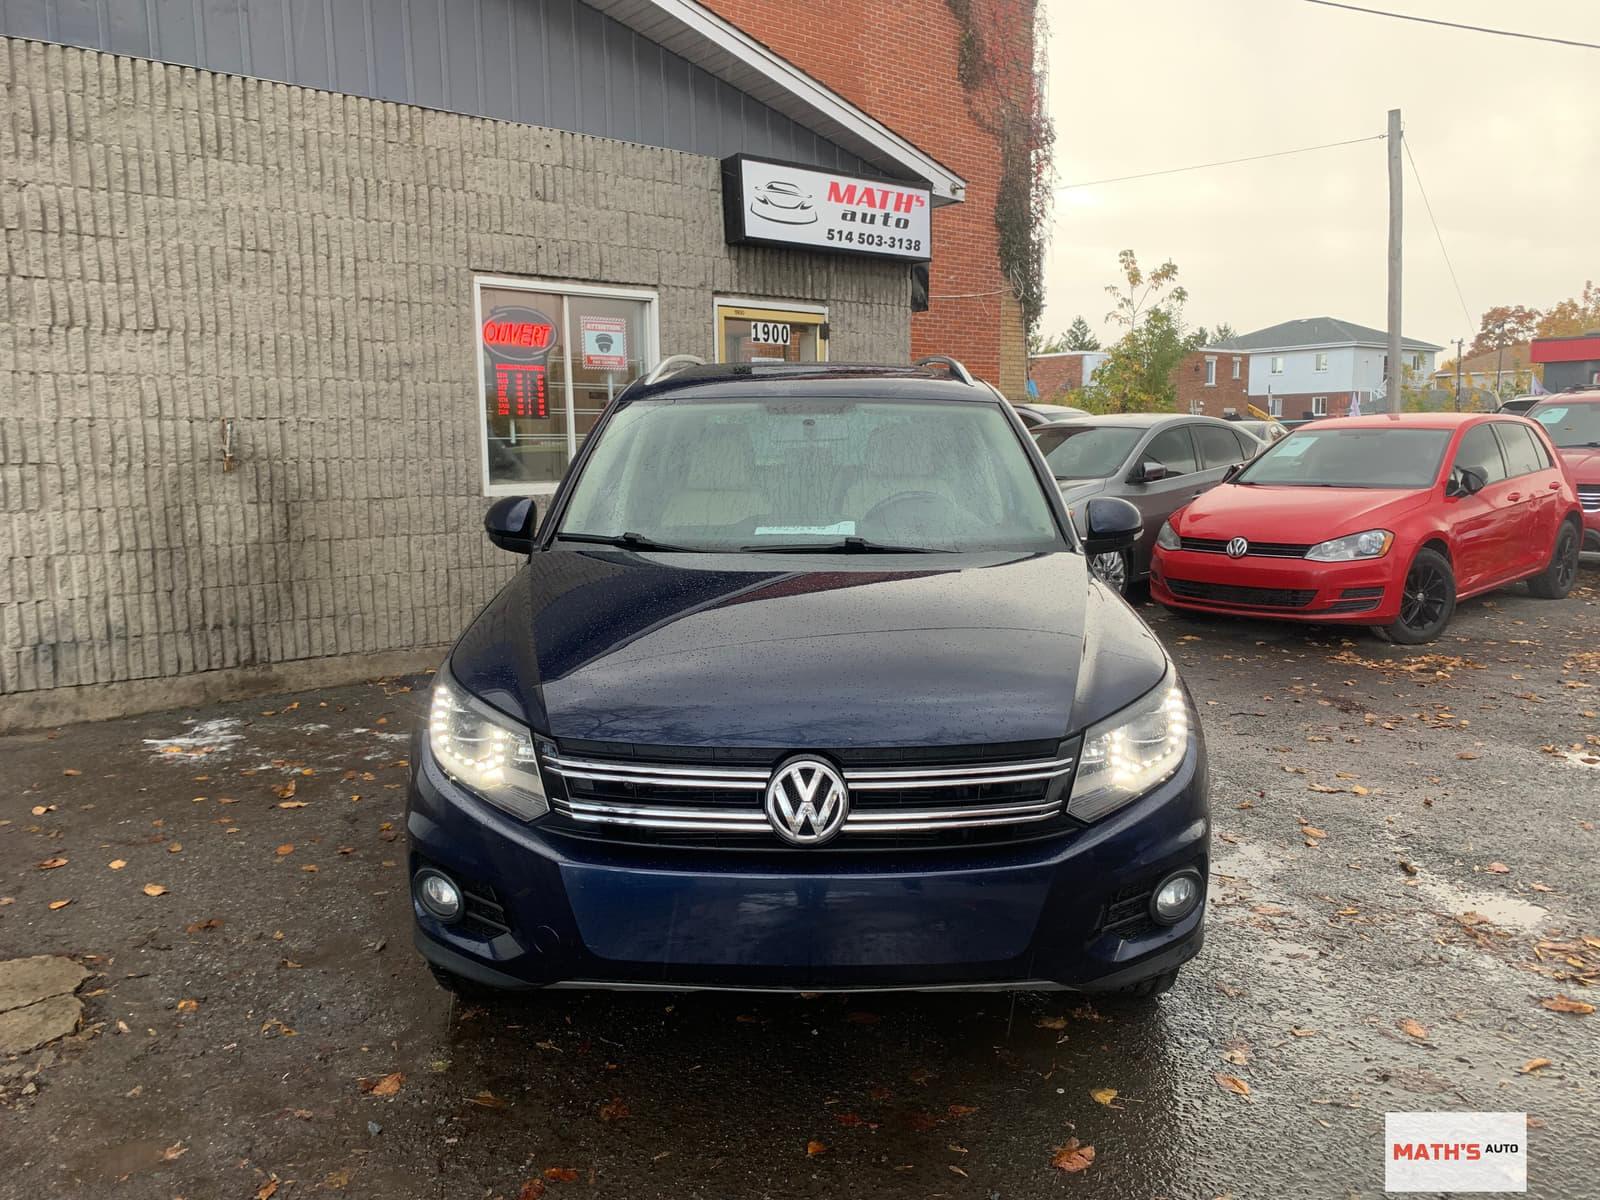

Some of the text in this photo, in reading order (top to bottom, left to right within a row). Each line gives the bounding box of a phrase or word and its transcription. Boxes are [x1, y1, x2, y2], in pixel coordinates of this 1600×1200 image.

[841, 209, 909, 229] auto
[826, 228, 921, 252] 514 503-3138
[484, 321, 552, 347] OUVERT
[752, 322, 789, 344] 1900
[769, 759, 845, 841] VW
